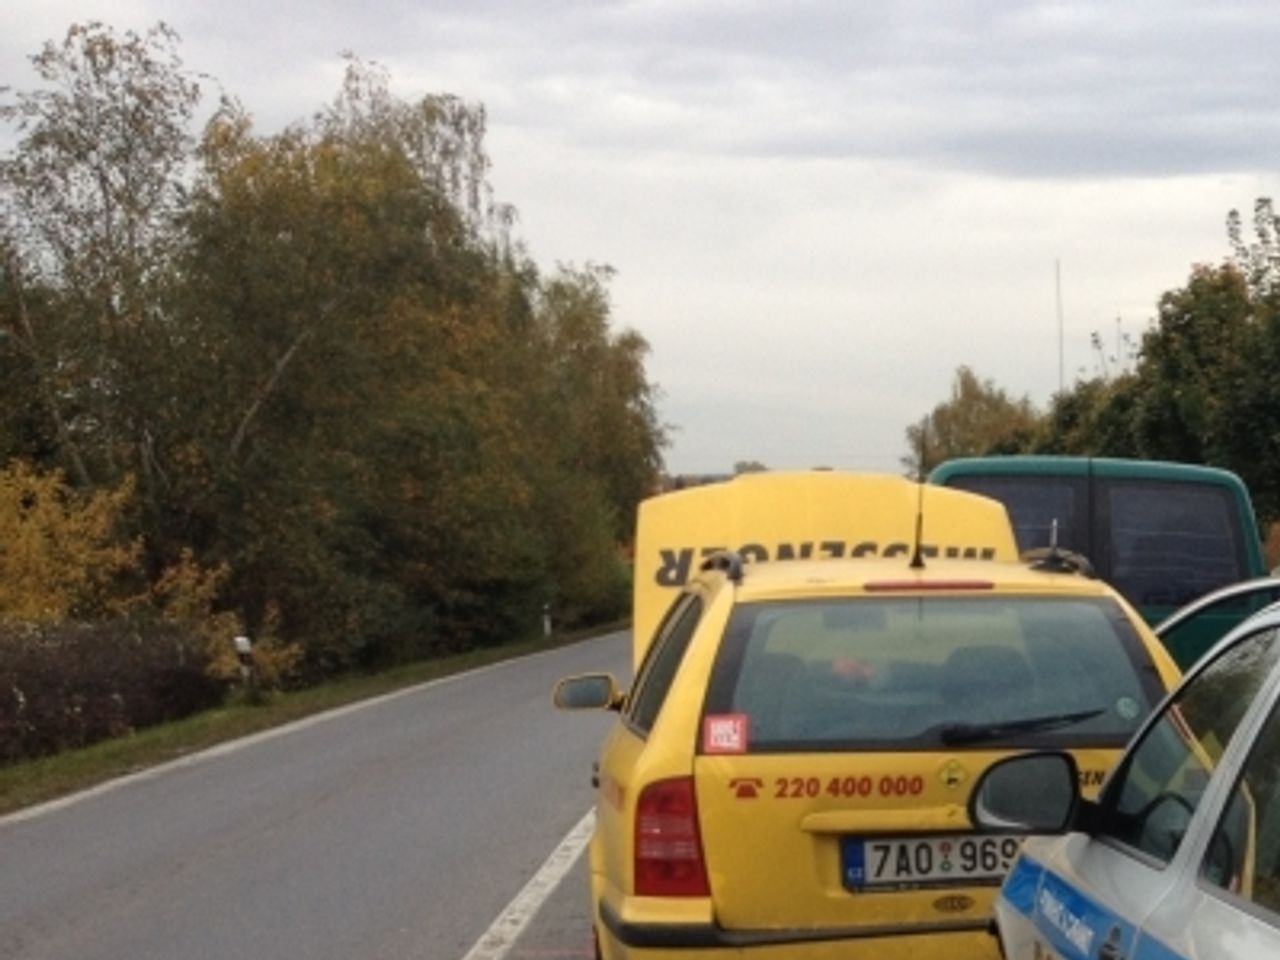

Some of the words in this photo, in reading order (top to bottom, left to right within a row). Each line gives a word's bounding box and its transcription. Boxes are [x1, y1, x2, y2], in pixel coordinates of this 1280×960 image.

[775, 777, 820, 798] 220
[826, 777, 872, 797] 400
[879, 775, 923, 796] 000
[960, 837, 1025, 873] 969
